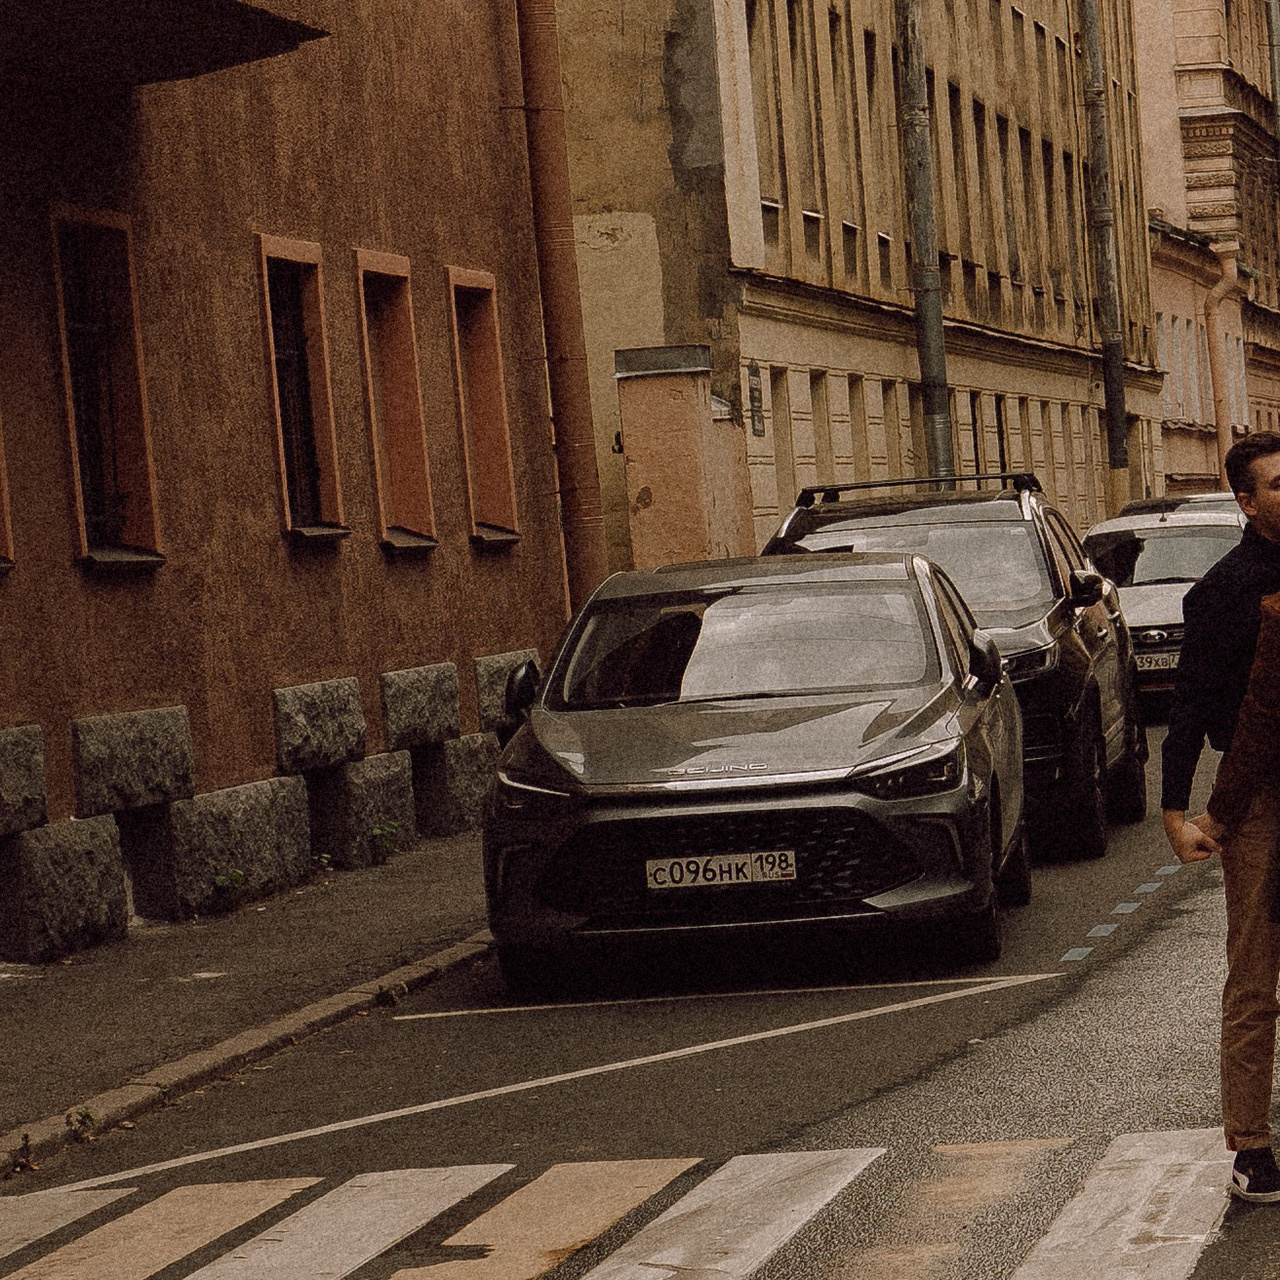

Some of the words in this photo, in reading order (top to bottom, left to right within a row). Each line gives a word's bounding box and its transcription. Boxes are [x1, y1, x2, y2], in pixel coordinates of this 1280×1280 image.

[1137, 655, 1168, 668] 39ХВ
[653, 858, 749, 886] С096НК
[754, 852, 789, 872] 198
[763, 870, 780, 879] RUS
